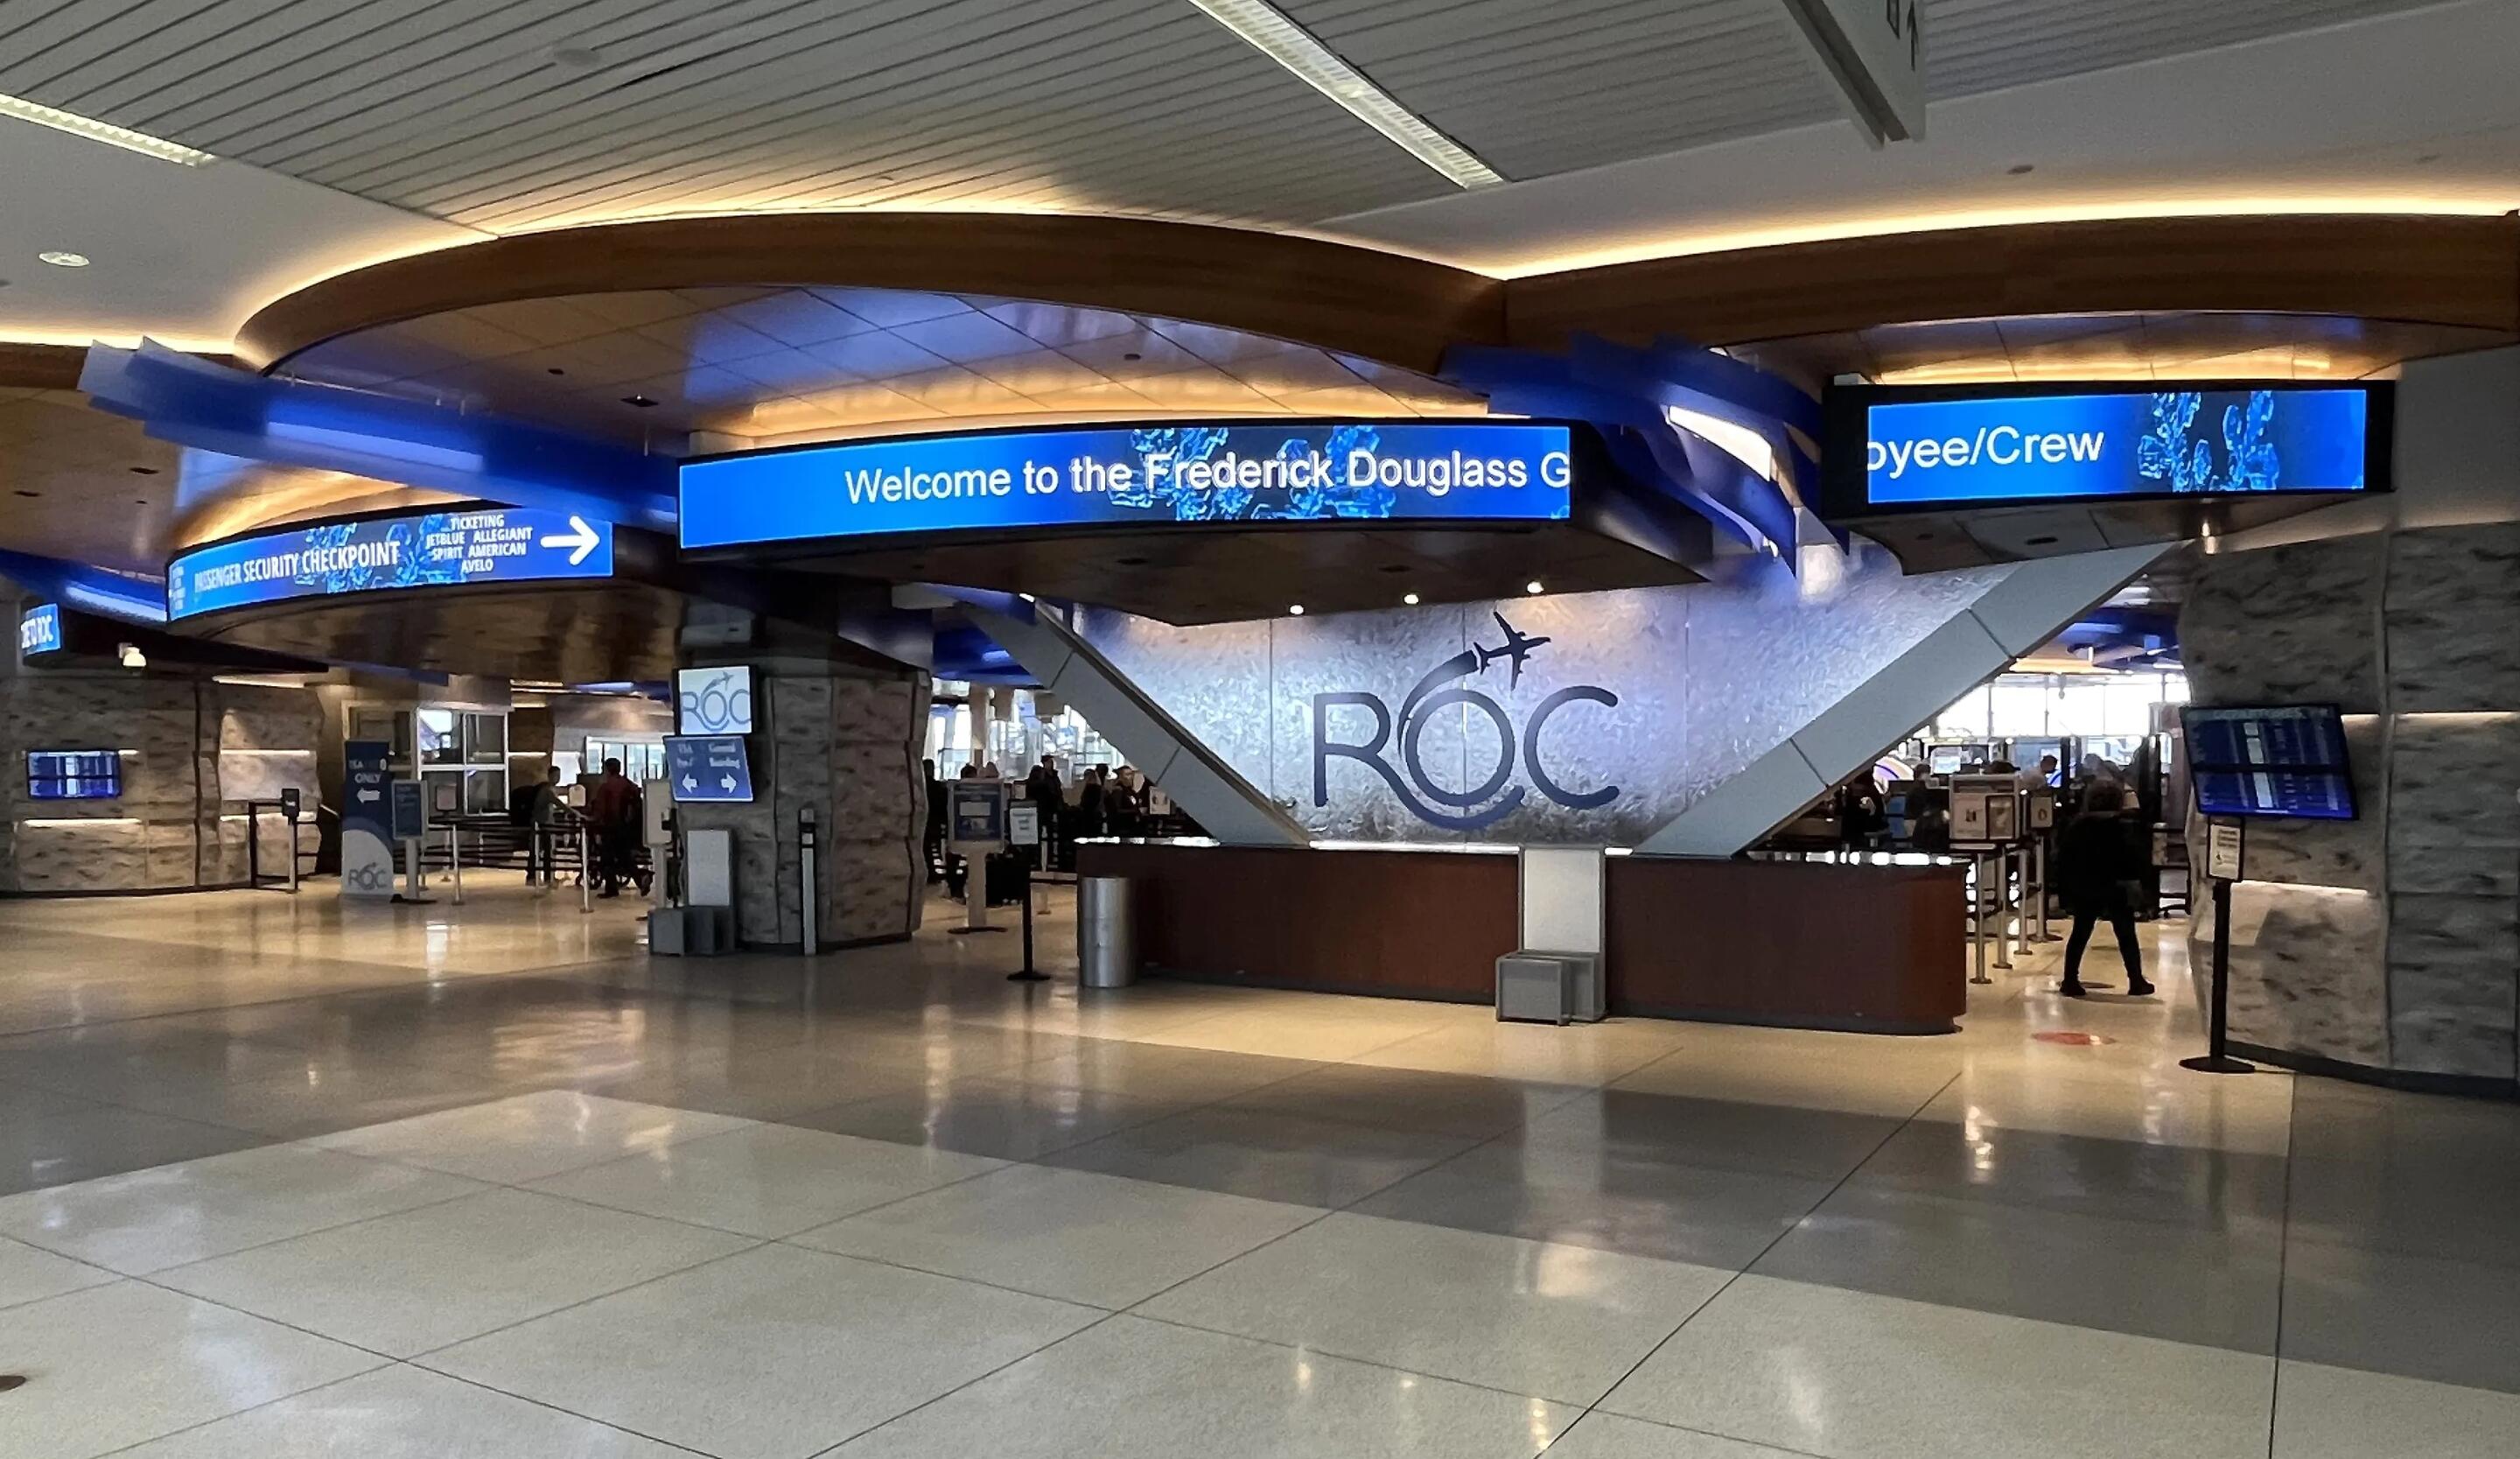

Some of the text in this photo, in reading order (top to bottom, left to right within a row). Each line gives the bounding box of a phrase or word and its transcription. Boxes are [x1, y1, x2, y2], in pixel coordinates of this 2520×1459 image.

[844, 449, 1571, 505] Welcome to the Frederick Douglass G
[450, 514, 505, 530] TICKETING
[426, 527, 533, 550] JETBLUE ALLEGIANT
[243, 552, 302, 583] SECURITY
[302, 541, 402, 574] CHECKPOINT
[431, 542, 527, 561] SPIRIT AMERICAN
[461, 559, 494, 573] AVELO
[1313, 684, 1620, 831] ROC
[347, 867, 388, 891] ROC
